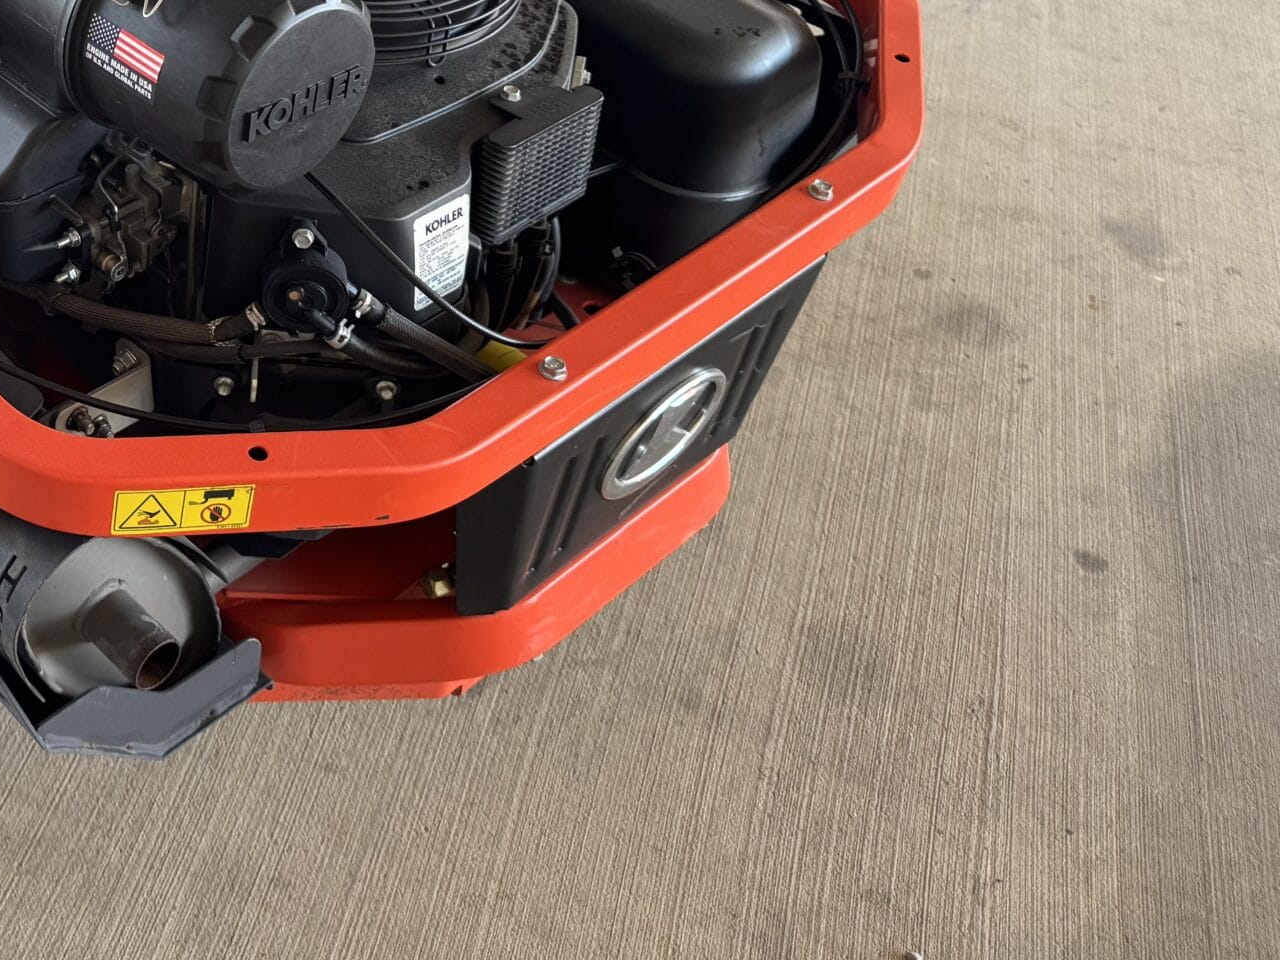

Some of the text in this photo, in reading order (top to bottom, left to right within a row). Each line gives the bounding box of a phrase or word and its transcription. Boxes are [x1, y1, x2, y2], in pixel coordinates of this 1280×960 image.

[85, 51, 93, 60] OF
[103, 63, 114, 75] AND
[114, 71, 134, 89] GLOBAL
[134, 85, 152, 100] PARTS
[86, 42, 153, 93] ENGINE MADE IN USA
[241, 64, 366, 144] KOHLER
[425, 207, 464, 236] KOHLER
